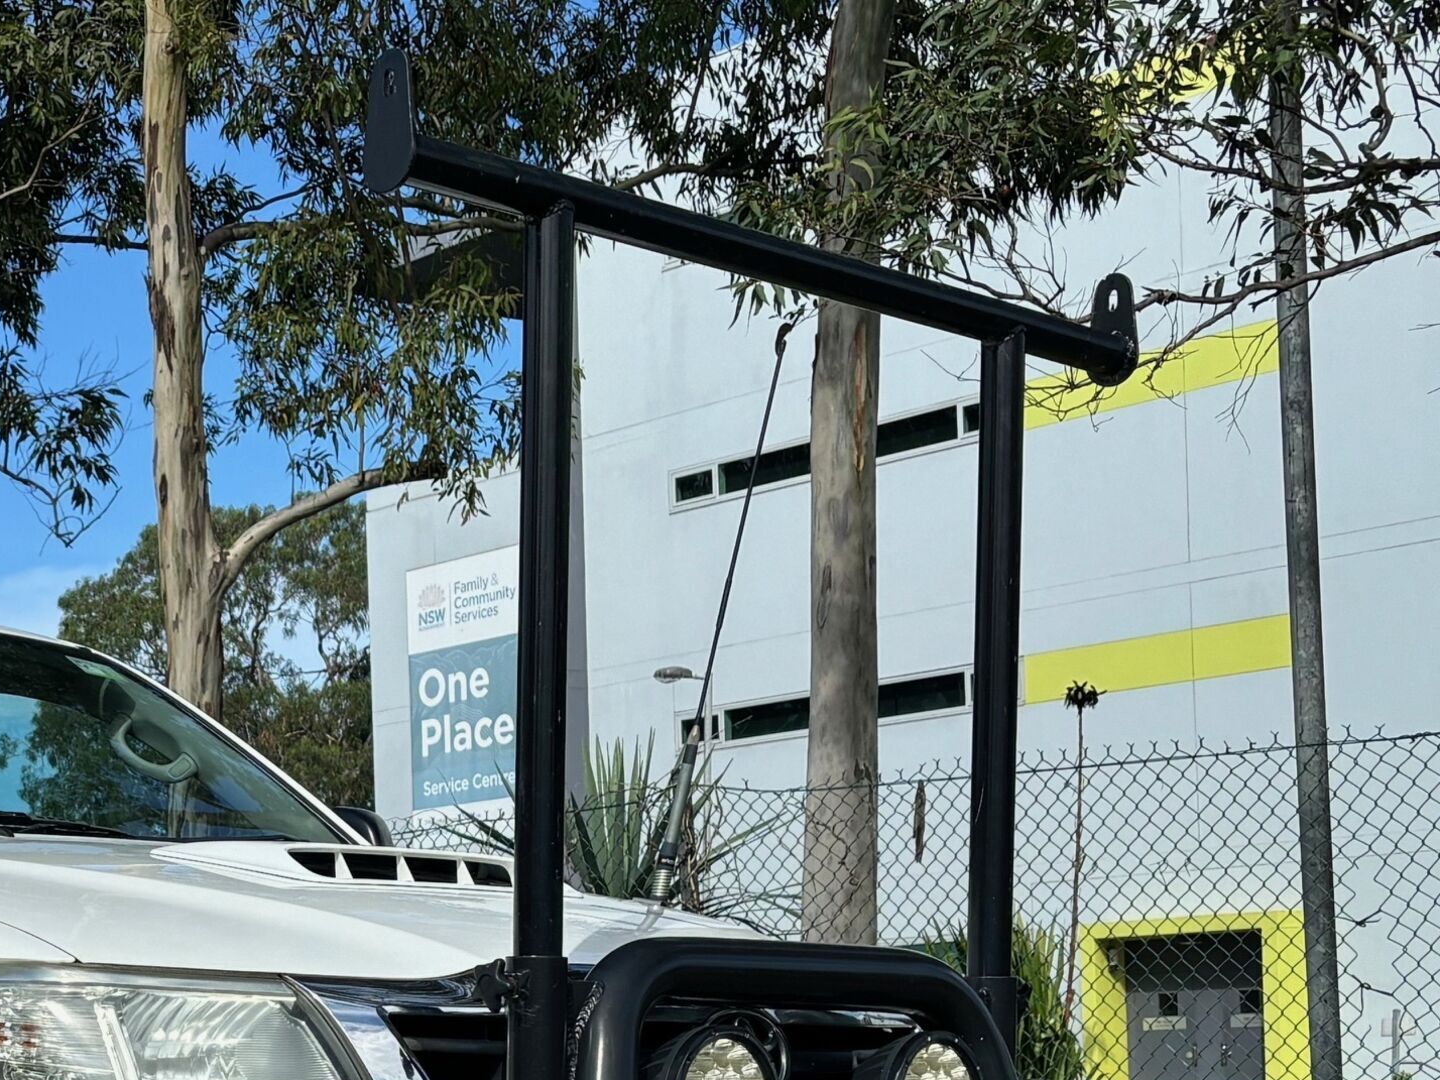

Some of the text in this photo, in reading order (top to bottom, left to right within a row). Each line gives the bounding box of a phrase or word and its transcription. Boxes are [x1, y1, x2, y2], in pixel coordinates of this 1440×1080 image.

[454, 572, 499, 595] Family &
[454, 586, 516, 609] Community
[418, 607, 446, 626] NSW
[454, 606, 499, 625] Services
[418, 667, 490, 708] One
[420, 711, 515, 758] Place
[423, 777, 469, 797] Service
